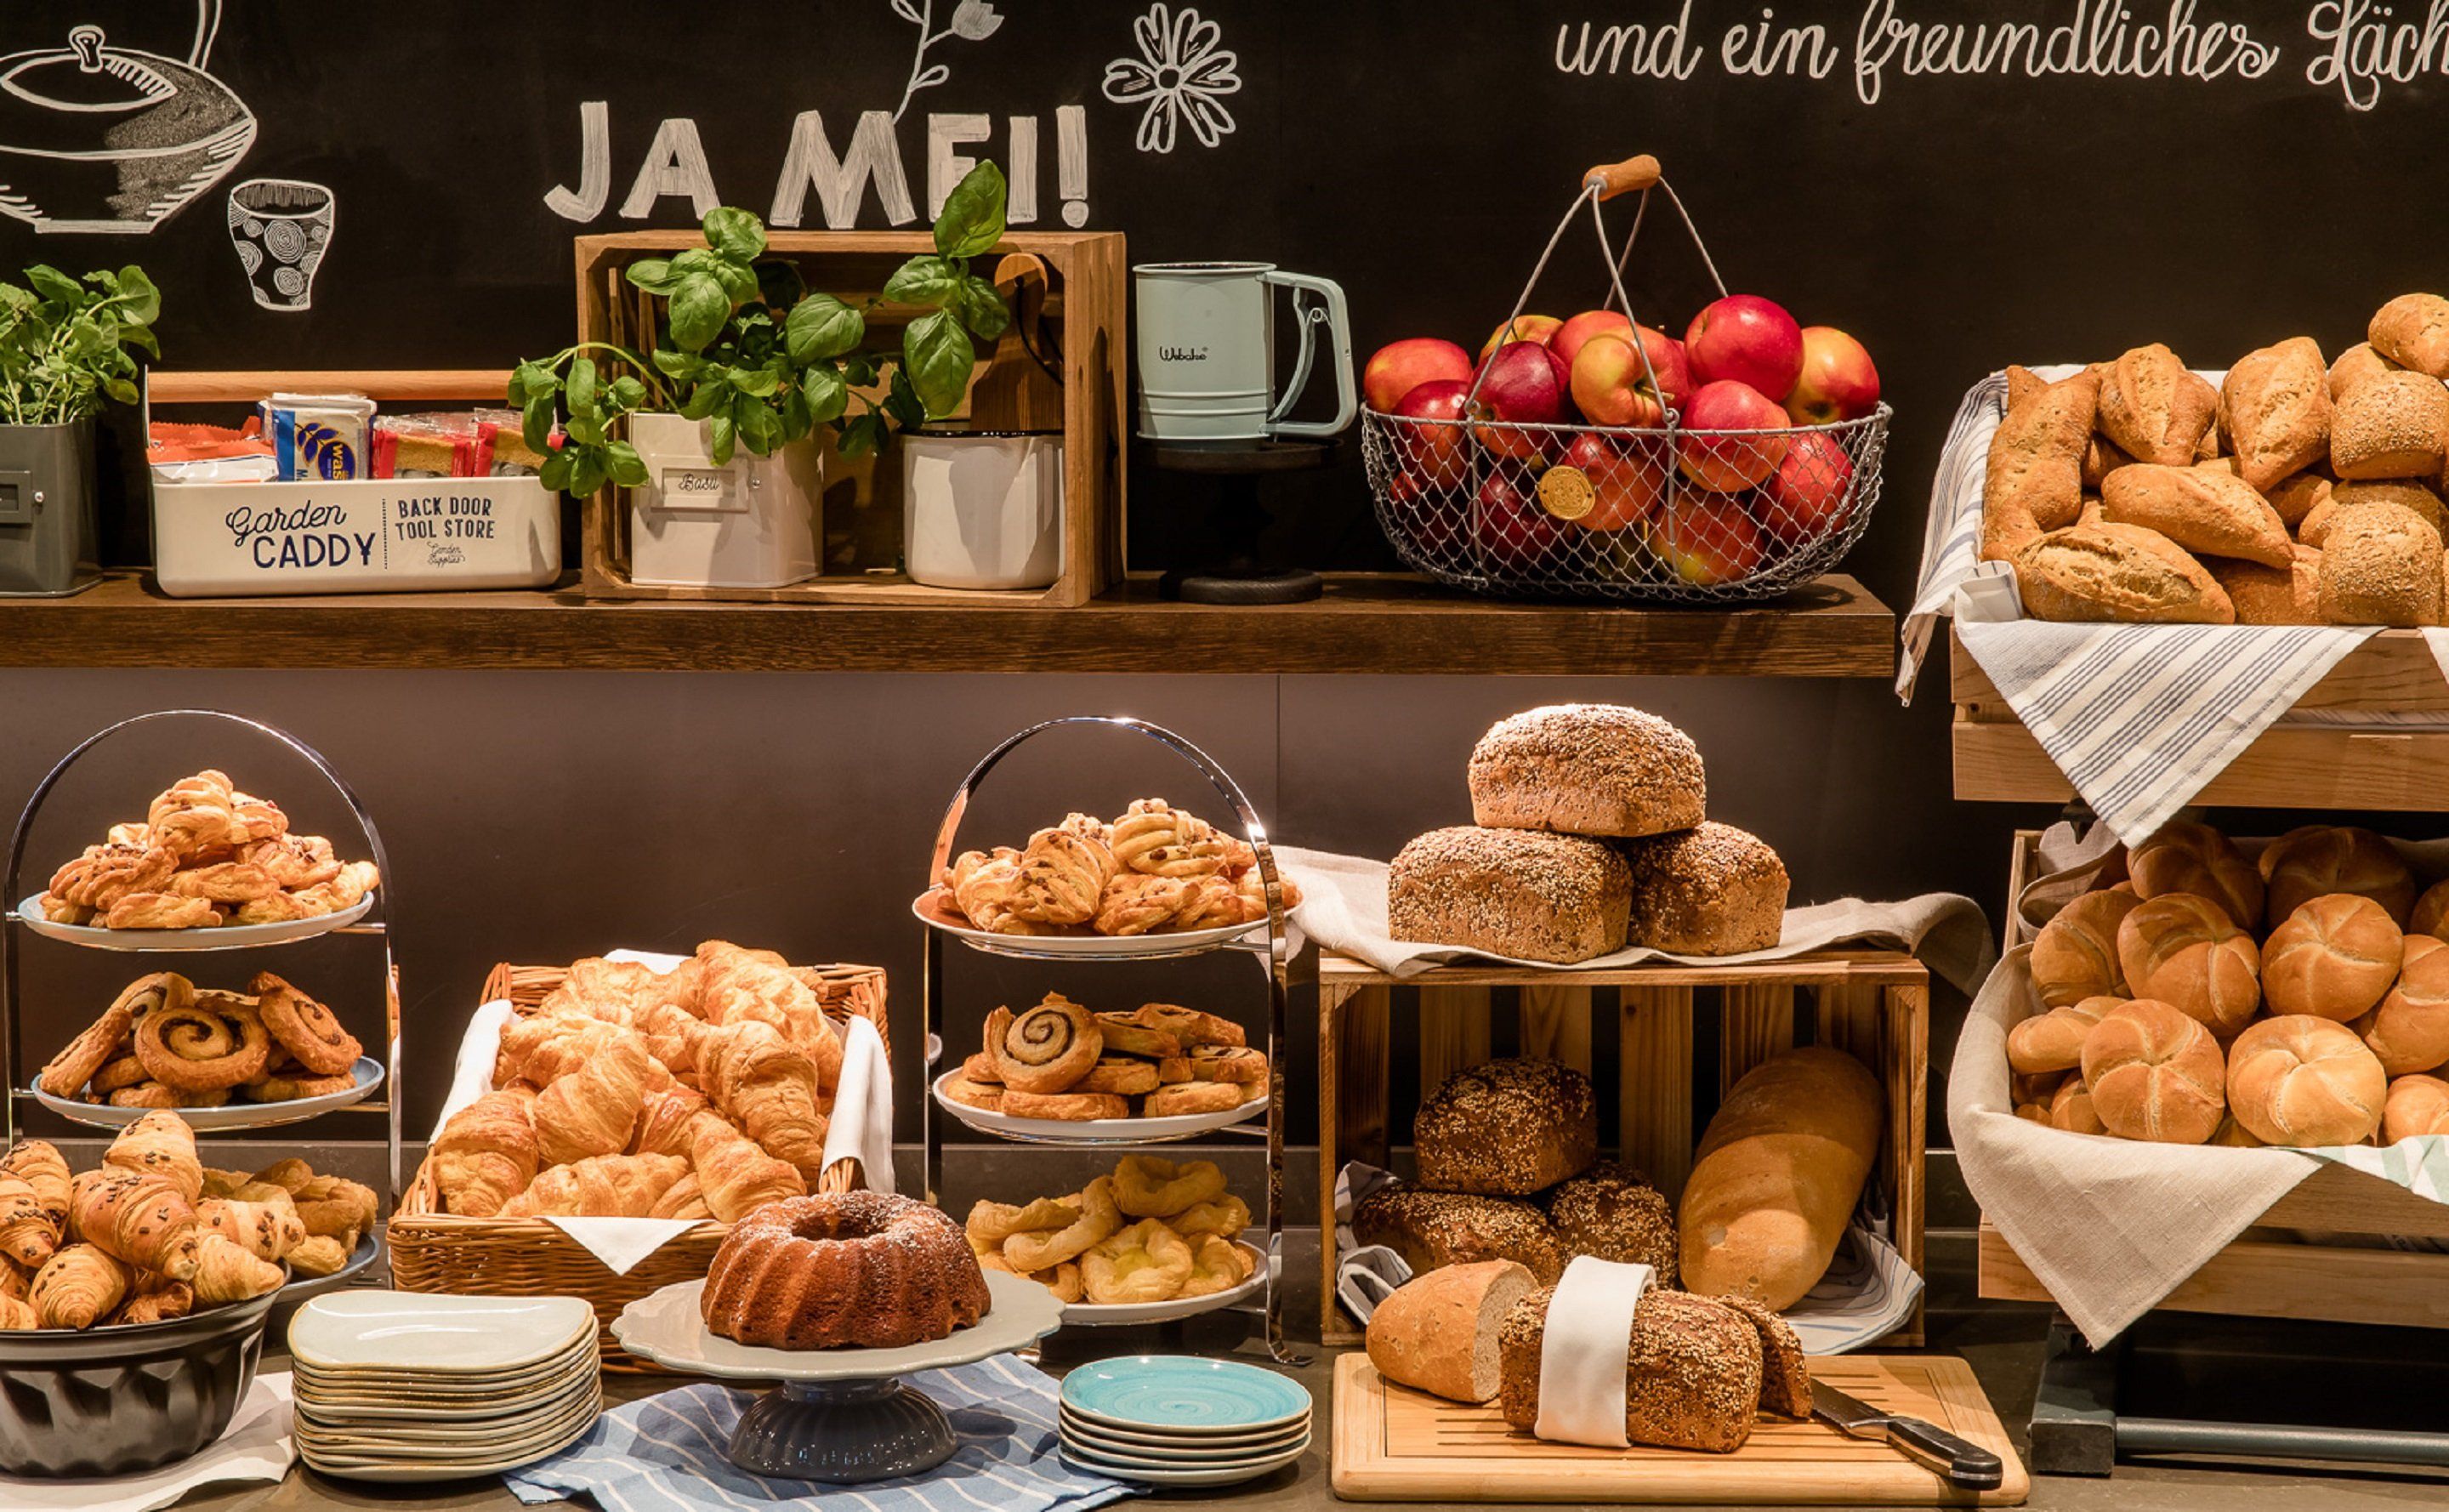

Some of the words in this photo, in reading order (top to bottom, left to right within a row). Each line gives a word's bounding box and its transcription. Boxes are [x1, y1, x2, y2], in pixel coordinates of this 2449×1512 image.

[1555, 0, 1703, 80] und
[1721, 8, 1839, 79] ein
[1854, 0, 2281, 105] freundliches
[543, 100, 721, 224] JA
[225, 499, 348, 547] Garden
[398, 497, 442, 519] BACK
[449, 497, 492, 516] DOOR
[253, 531, 376, 569] CADDY
[395, 520, 437, 541] TOOL
[444, 519, 496, 539] STORE
